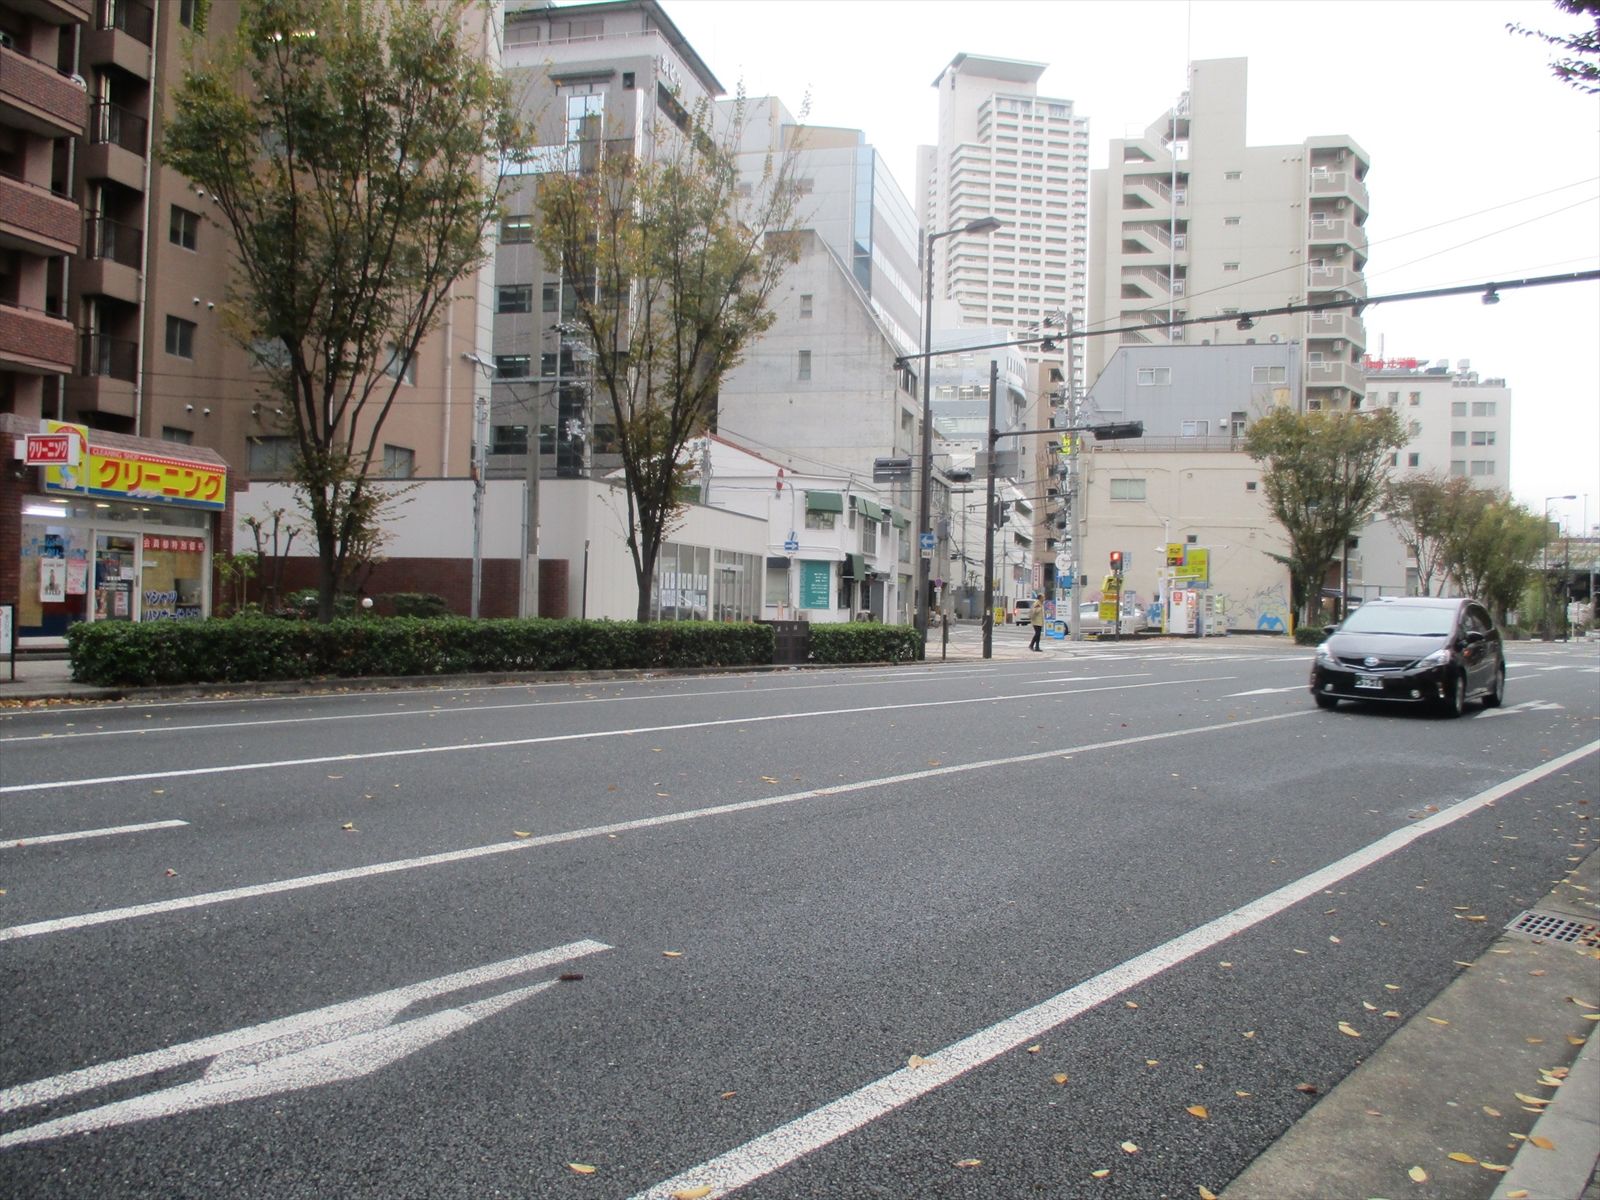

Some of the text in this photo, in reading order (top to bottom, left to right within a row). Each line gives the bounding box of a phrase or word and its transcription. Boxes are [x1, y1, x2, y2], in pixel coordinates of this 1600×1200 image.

[92, 448, 122, 459] CLEANING
[99, 460, 221, 499] クリーニング
